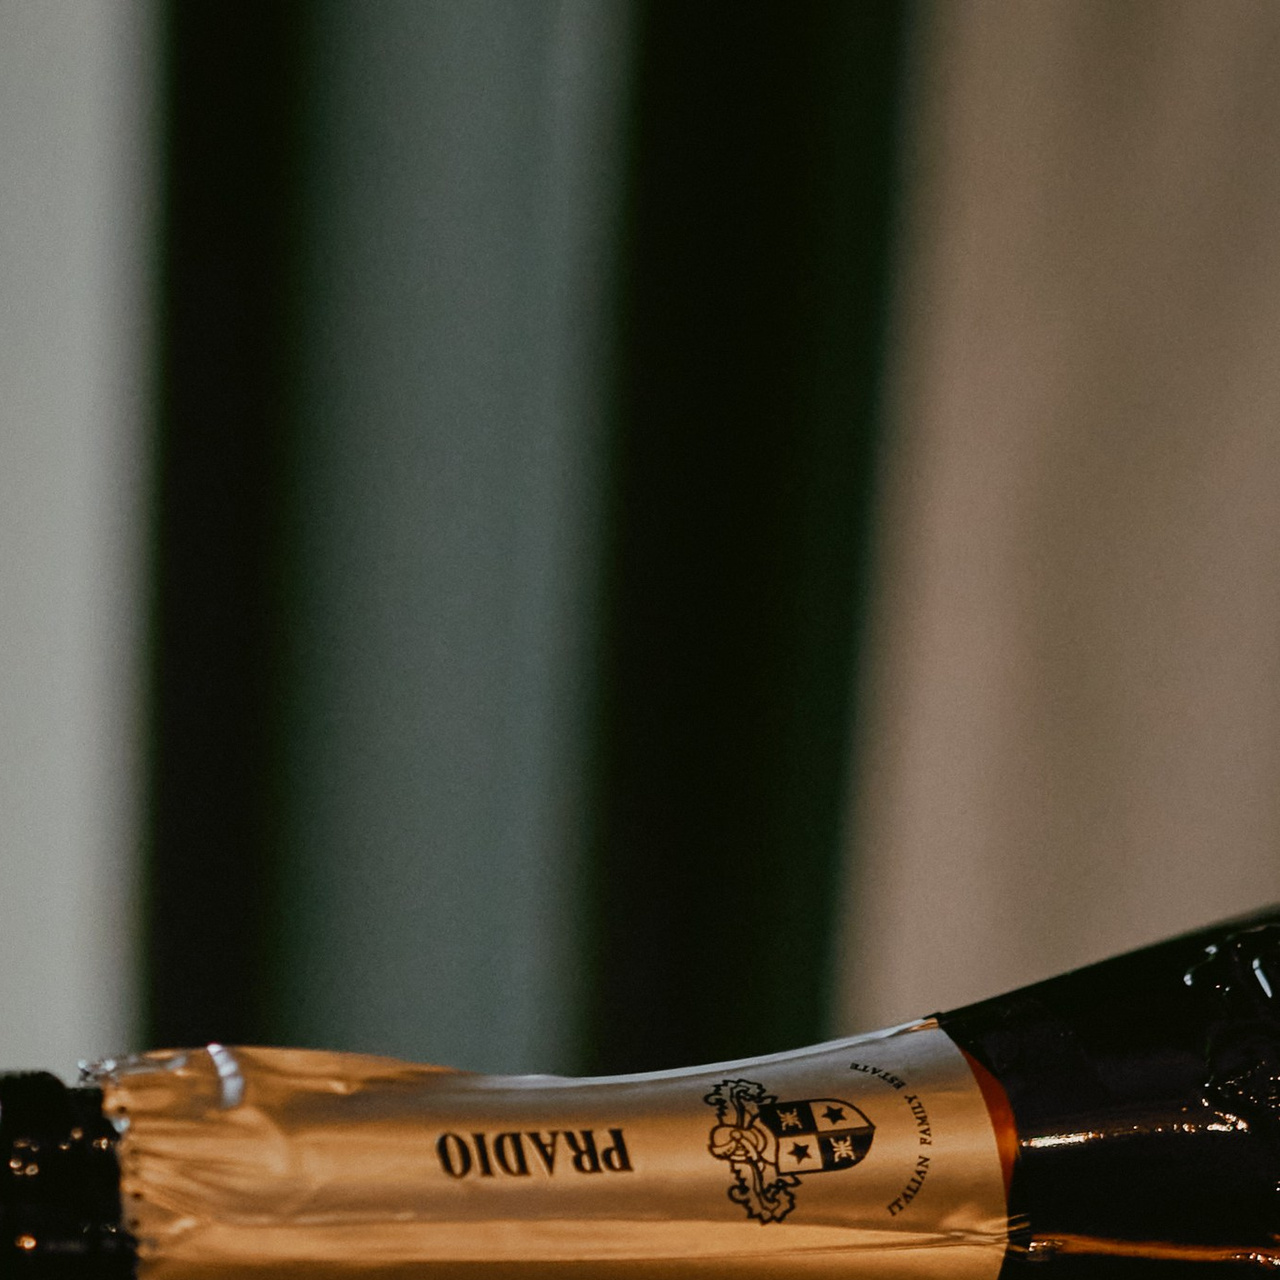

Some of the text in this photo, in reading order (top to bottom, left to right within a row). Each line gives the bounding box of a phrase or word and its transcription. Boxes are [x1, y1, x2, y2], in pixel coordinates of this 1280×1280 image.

[437, 1128, 634, 1180] PRADIO
[850, 1062, 932, 1217] ITALIAN FAMILY ESTATE
